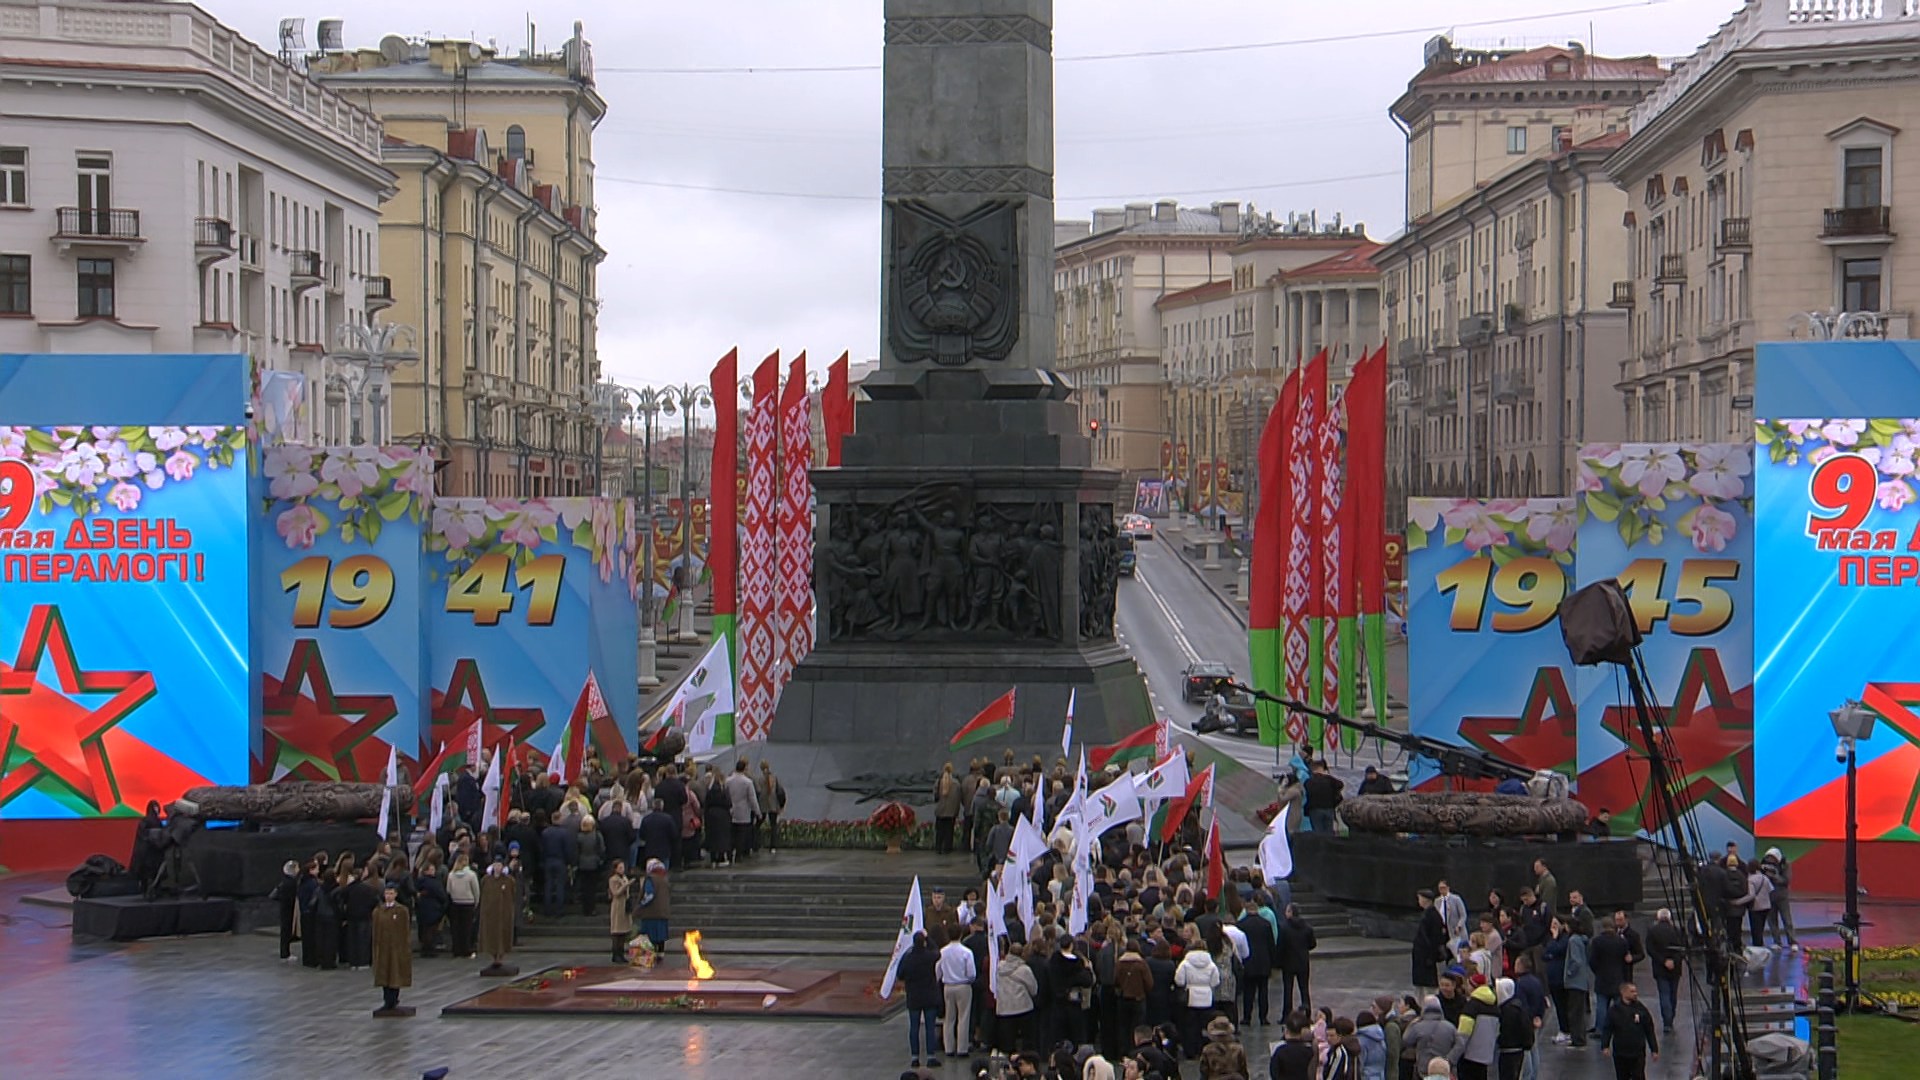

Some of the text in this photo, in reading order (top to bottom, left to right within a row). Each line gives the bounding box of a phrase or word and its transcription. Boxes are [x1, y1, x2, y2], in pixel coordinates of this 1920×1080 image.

[1809, 455, 1876, 536] 9
[64, 518, 192, 549] ДЗЕНЬ
[1385, 542, 1399, 560] 9
[4, 553, 205, 582] ПЕРАМОГІ!
[281, 554, 396, 629] 19
[445, 553, 566, 626] 41
[1838, 555, 1920, 586] ПЕР
[1435, 556, 1567, 633] 19
